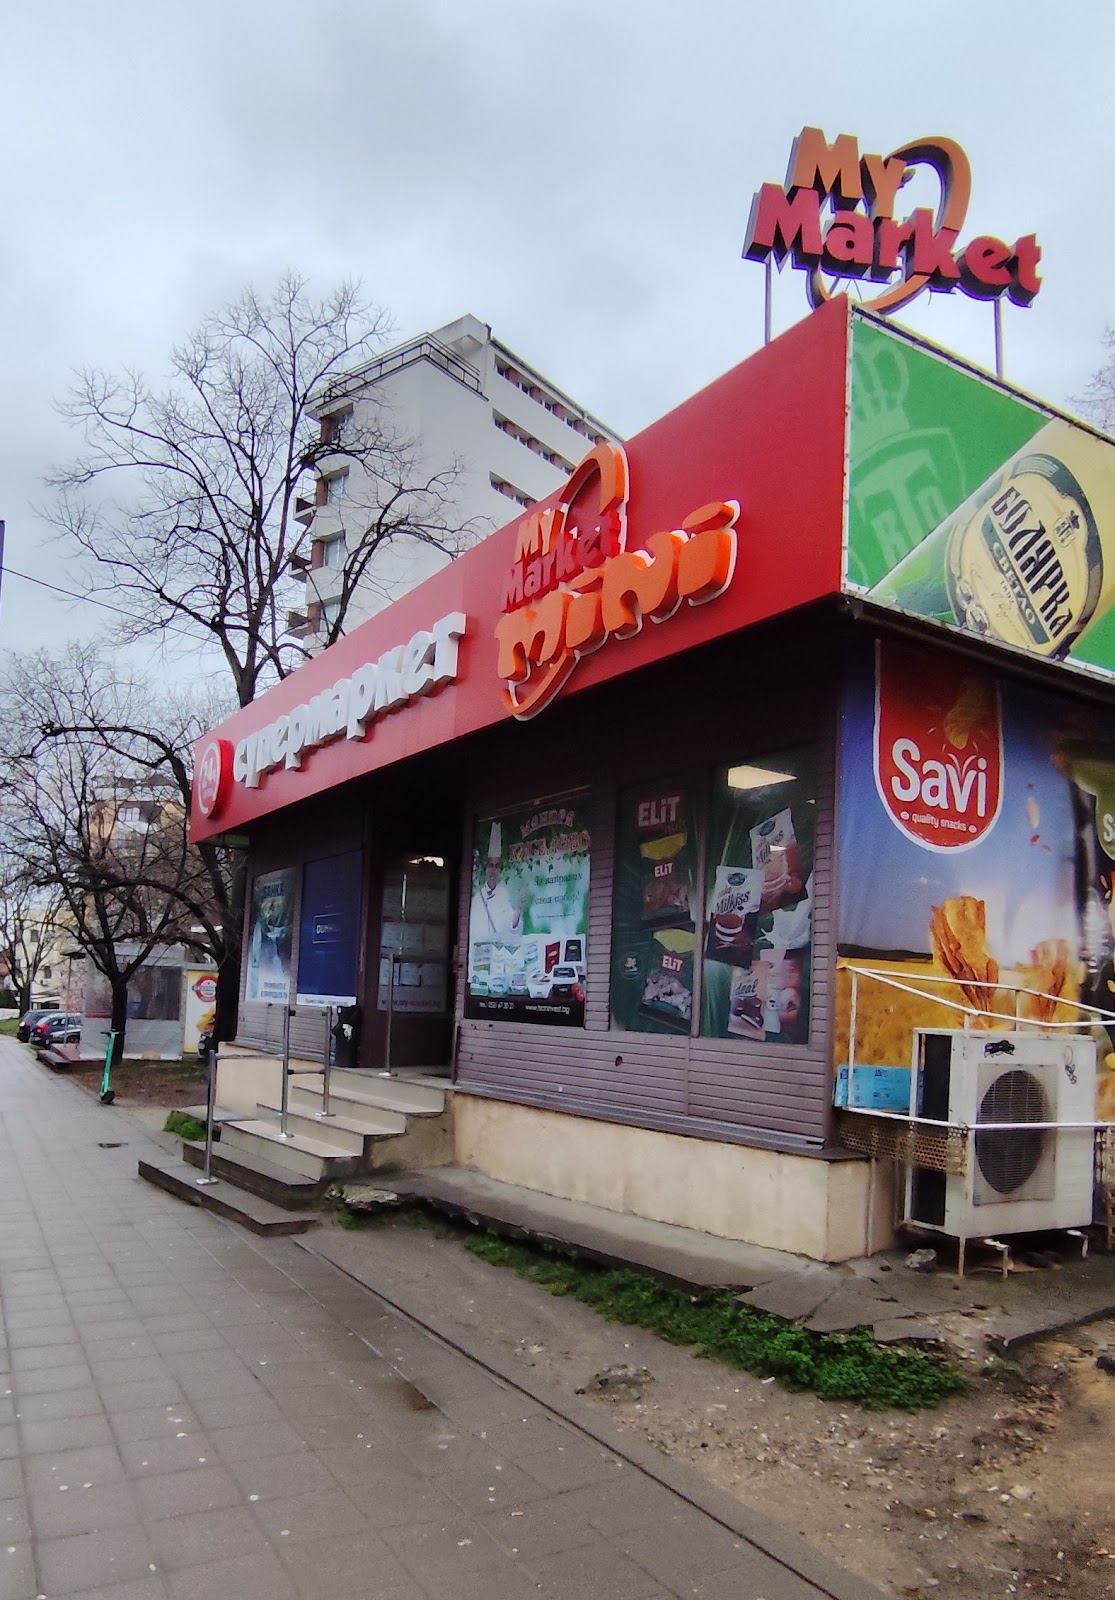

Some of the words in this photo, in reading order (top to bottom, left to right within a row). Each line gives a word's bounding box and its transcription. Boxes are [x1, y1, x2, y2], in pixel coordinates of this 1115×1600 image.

[746, 182, 1042, 304] Market
[494, 500, 740, 684] mini
[502, 511, 625, 613] Market
[991, 486, 1073, 638] БОЛЯРКА
[993, 542, 1036, 625] СВЕТЛО
[233, 612, 467, 788] супермаркет
[891, 738, 987, 818] Savi
[911, 812, 939, 829] quality
[940, 818, 967, 832] snacks
[1102, 813, 1115, 843] S
[716, 891, 750, 914] Milkiss
